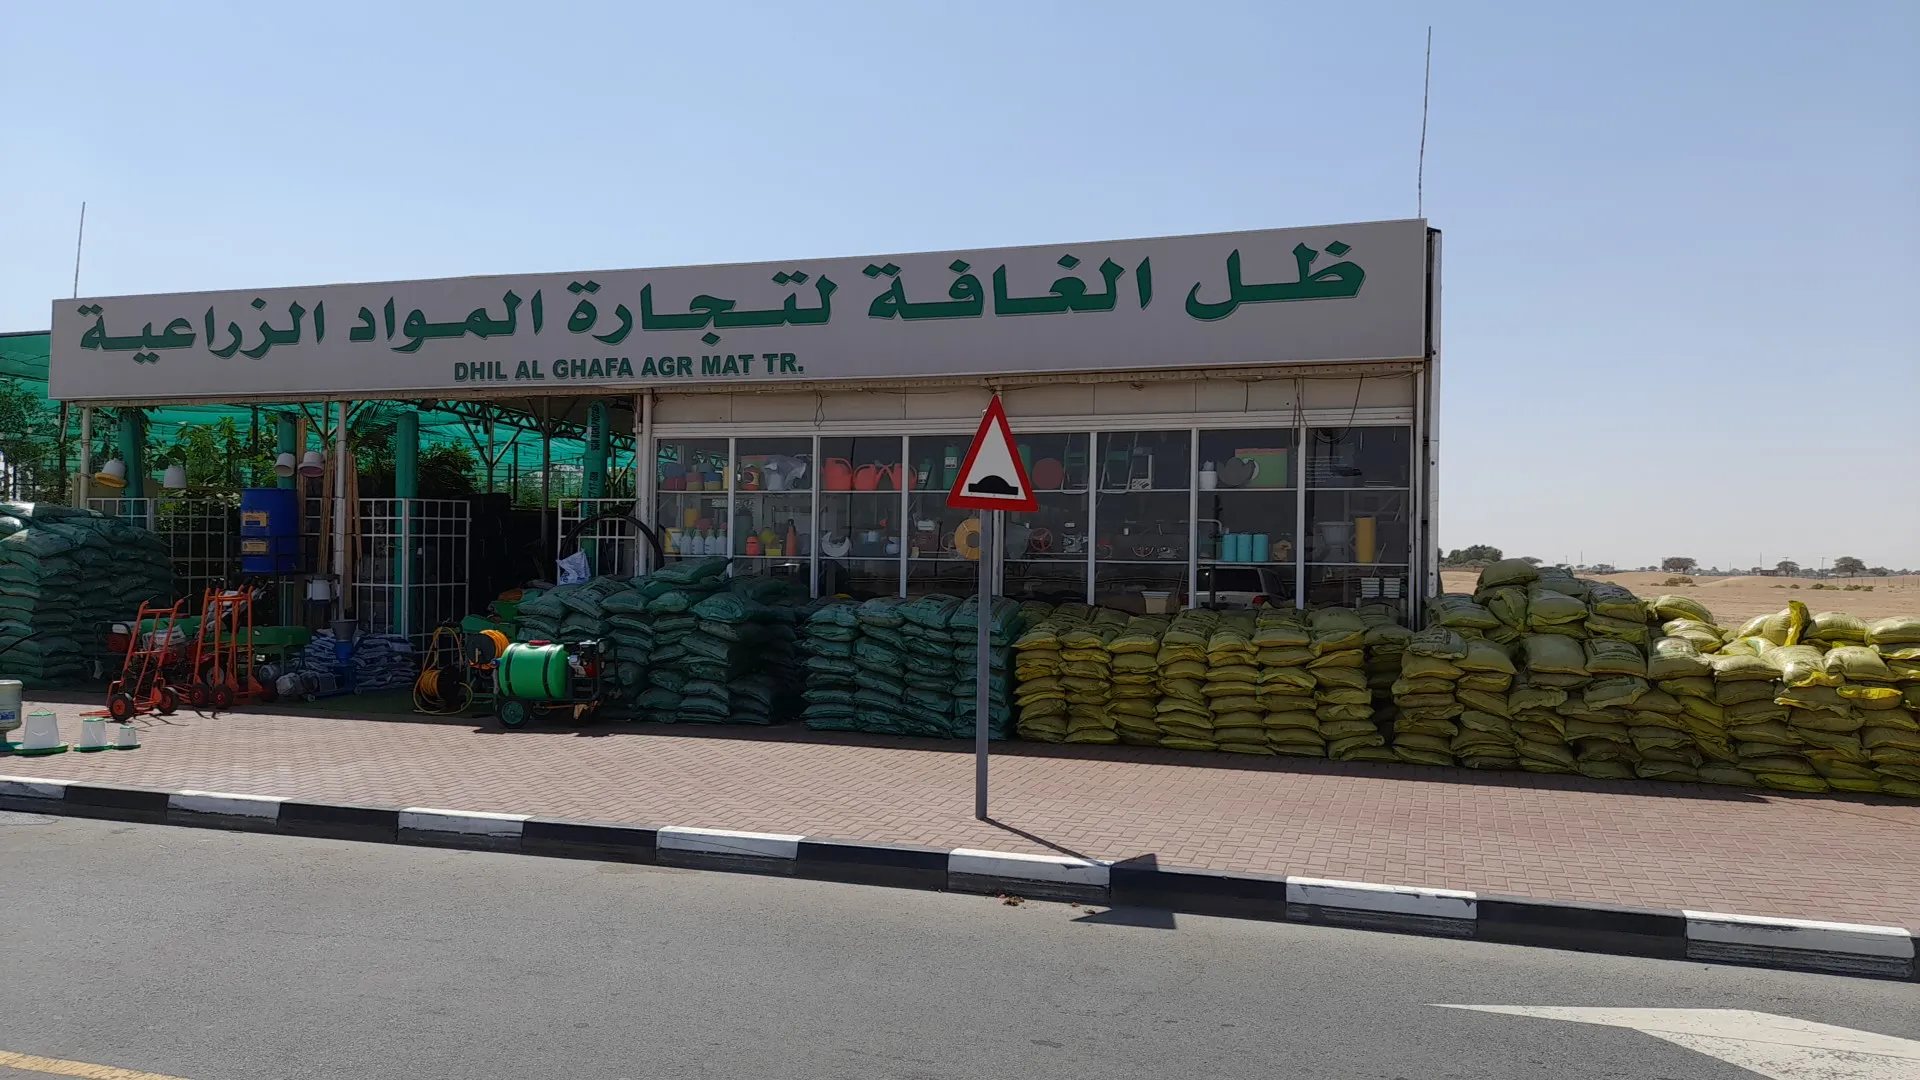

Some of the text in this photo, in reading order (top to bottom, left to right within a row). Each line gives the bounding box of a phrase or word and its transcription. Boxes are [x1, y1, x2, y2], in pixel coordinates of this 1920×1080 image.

[78, 241, 1366, 363] ظل الغافة لتجارة المواد الزراعية
[454, 352, 804, 382] DHIL AL GHAFA AGR MAT TR.
